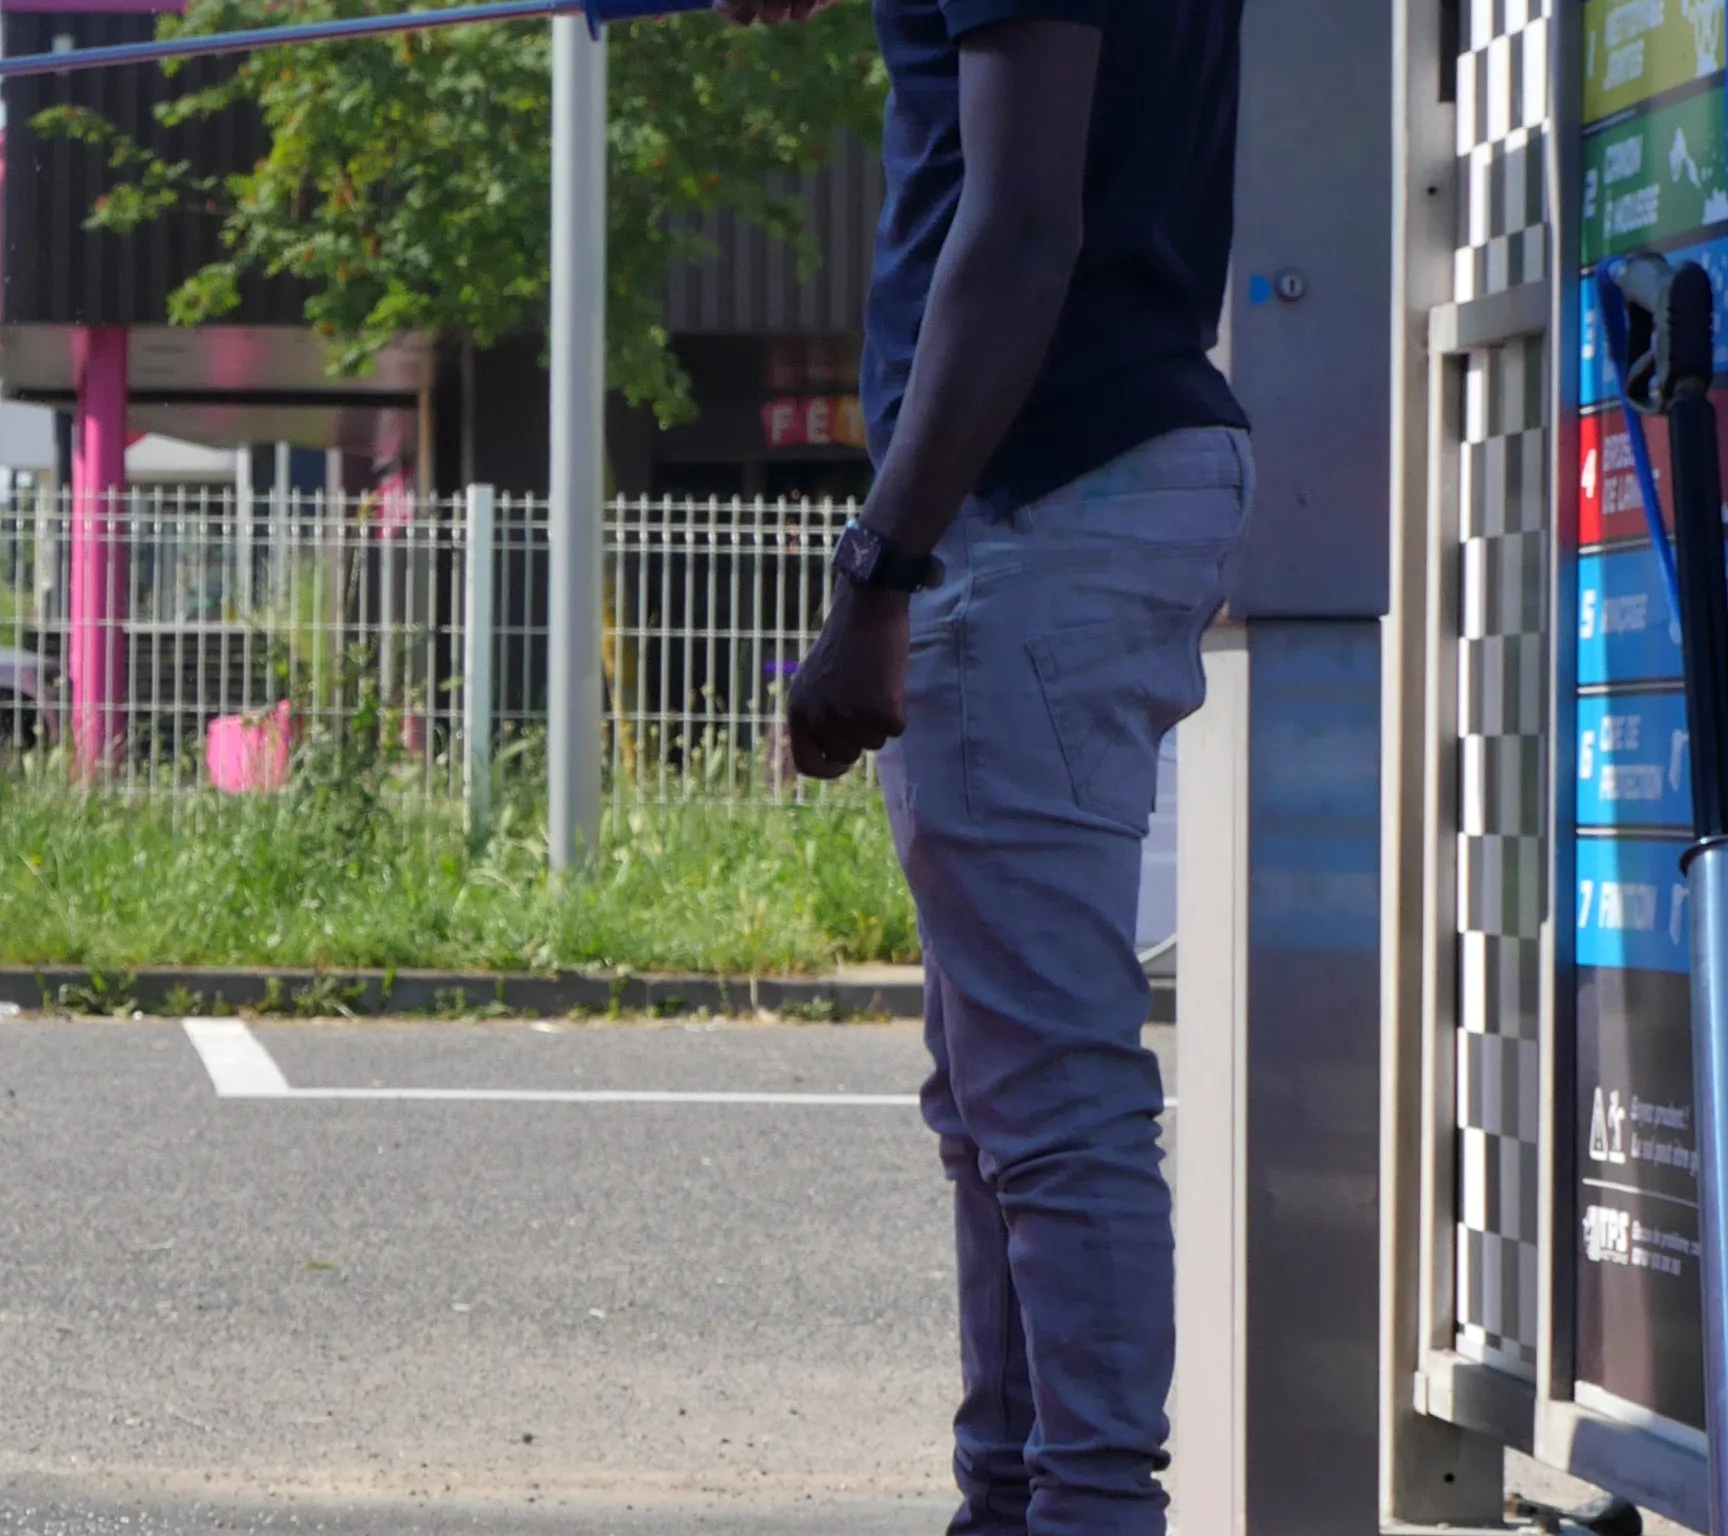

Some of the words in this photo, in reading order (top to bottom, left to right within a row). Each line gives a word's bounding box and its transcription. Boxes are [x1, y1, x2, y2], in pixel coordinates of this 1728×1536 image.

[1581, 448, 1597, 499] 4
[1580, 588, 1597, 639] 5
[1579, 729, 1595, 779] 6
[1578, 880, 1594, 928] 7
